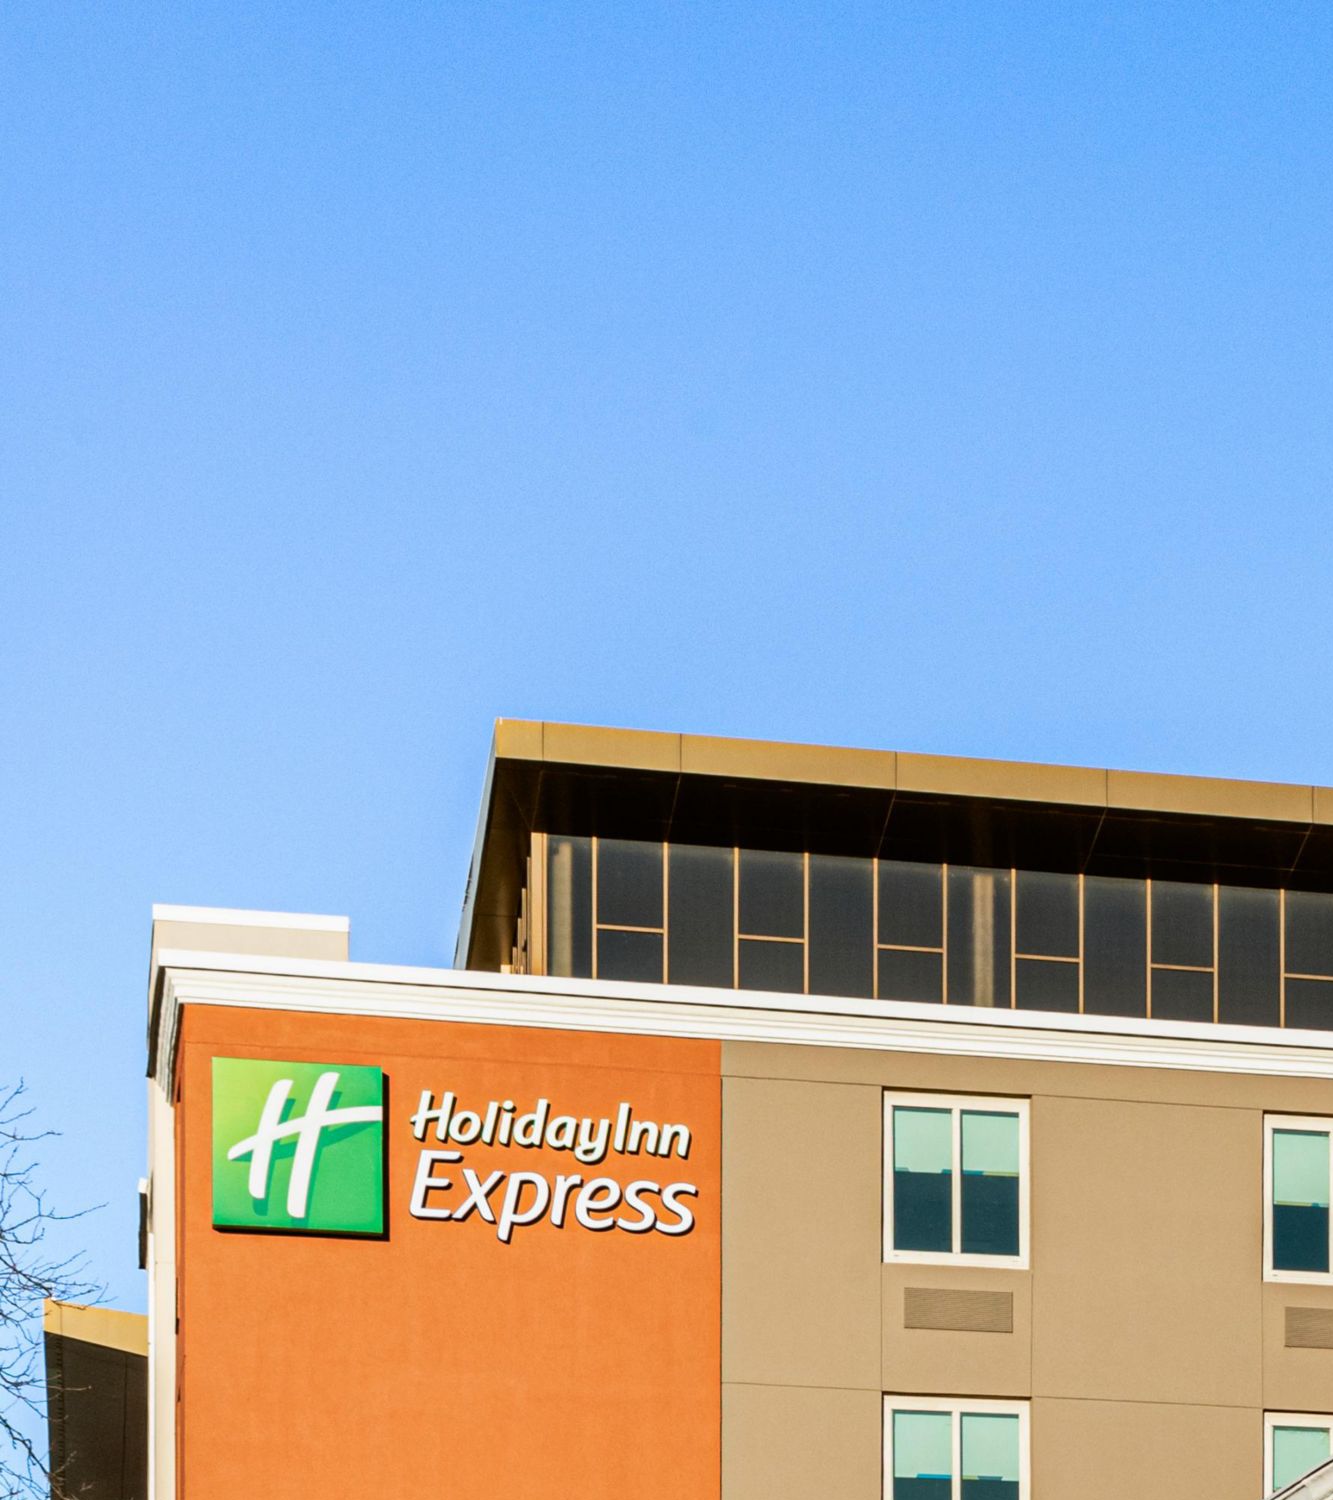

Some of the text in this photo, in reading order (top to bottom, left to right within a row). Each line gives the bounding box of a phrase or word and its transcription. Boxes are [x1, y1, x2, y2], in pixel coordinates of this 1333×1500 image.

[410, 1090, 691, 1163] Holiday Inn
[409, 1149, 698, 1243] Express
